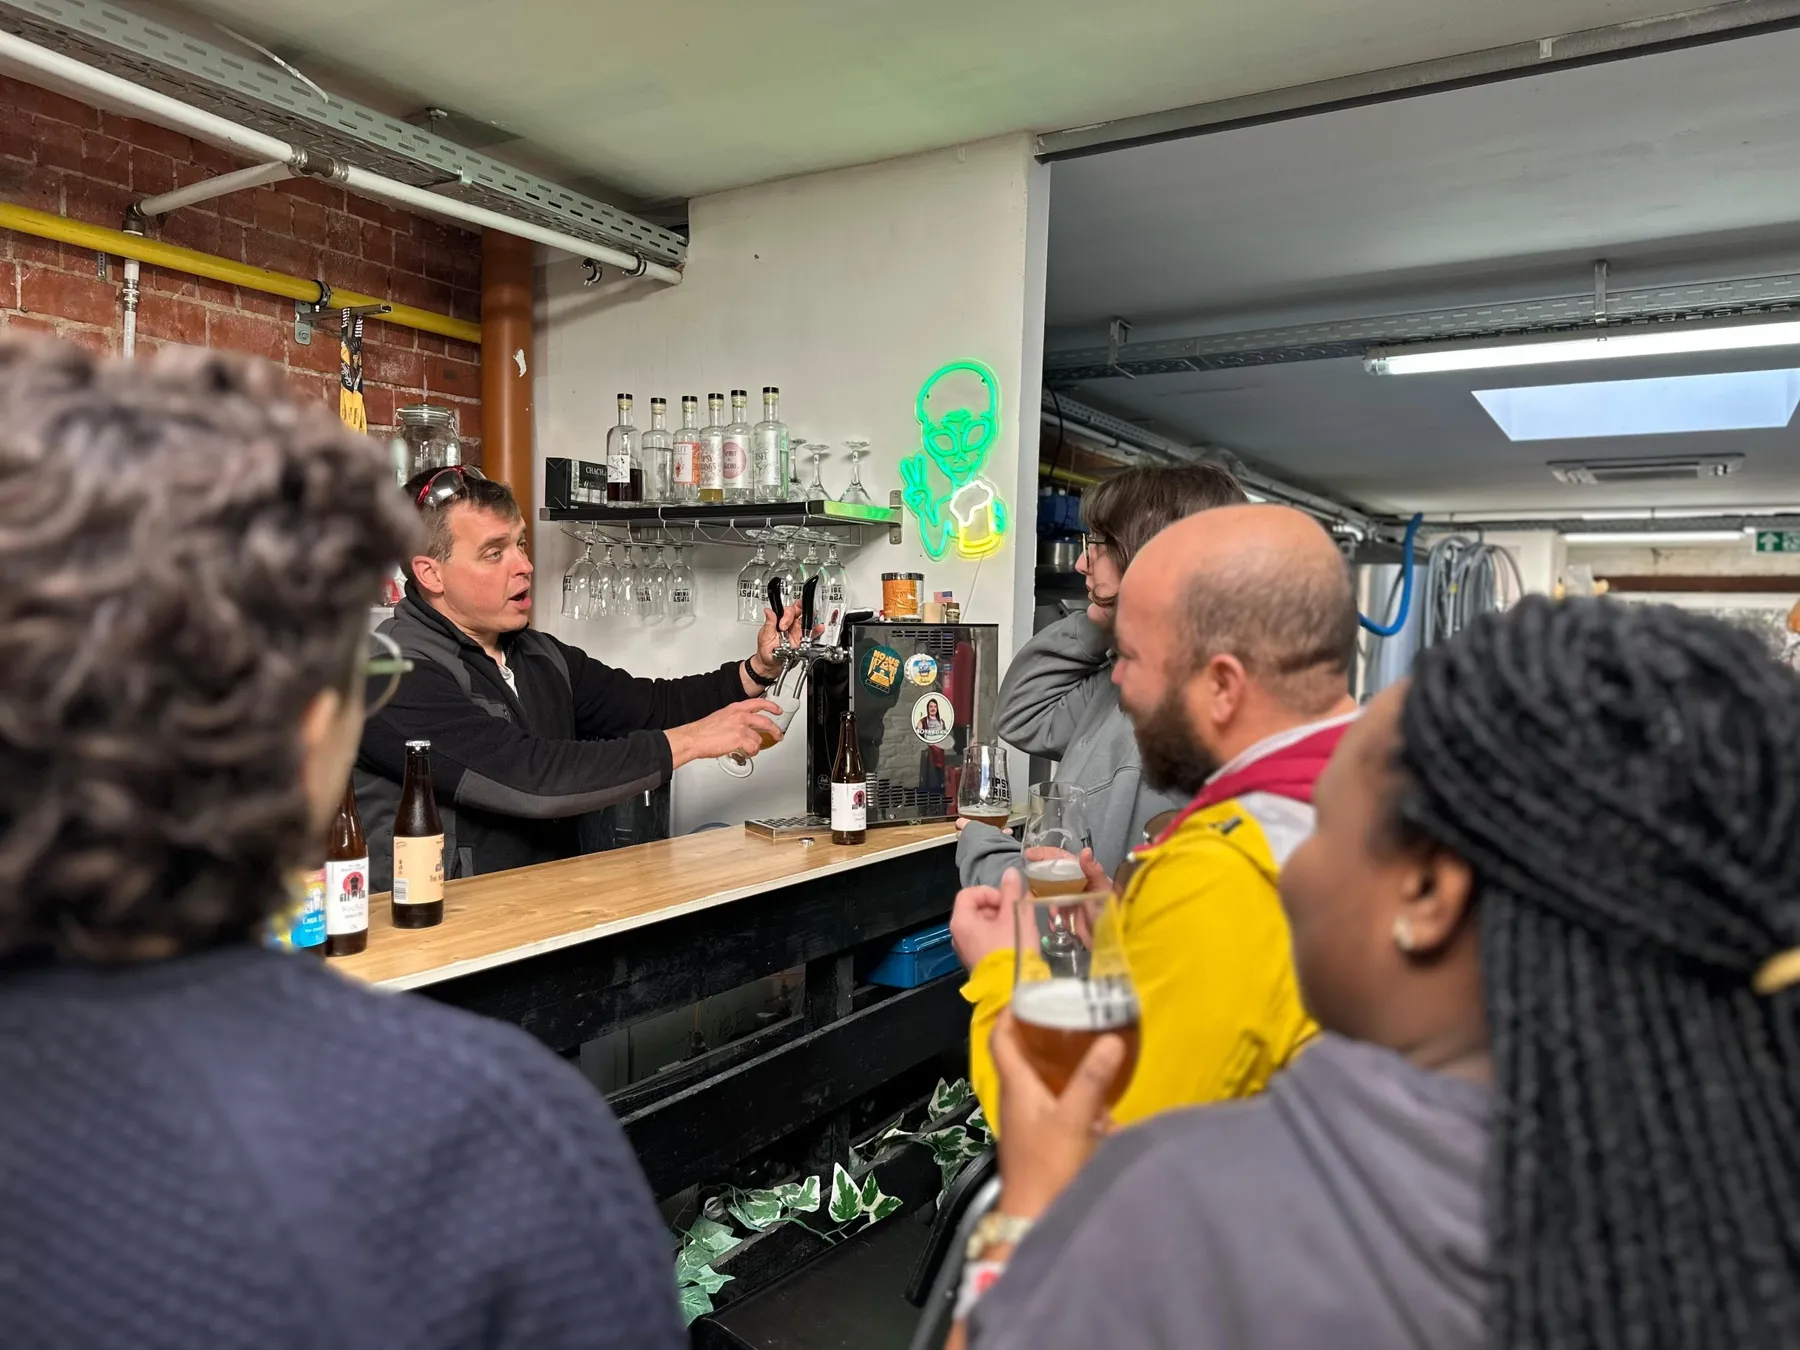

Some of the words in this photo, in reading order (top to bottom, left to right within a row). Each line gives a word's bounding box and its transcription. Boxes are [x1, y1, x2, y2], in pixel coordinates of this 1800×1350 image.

[739, 590, 760, 598] TIPSY
[991, 777, 1009, 789] IPSY
[992, 787, 1010, 799] RIBE
